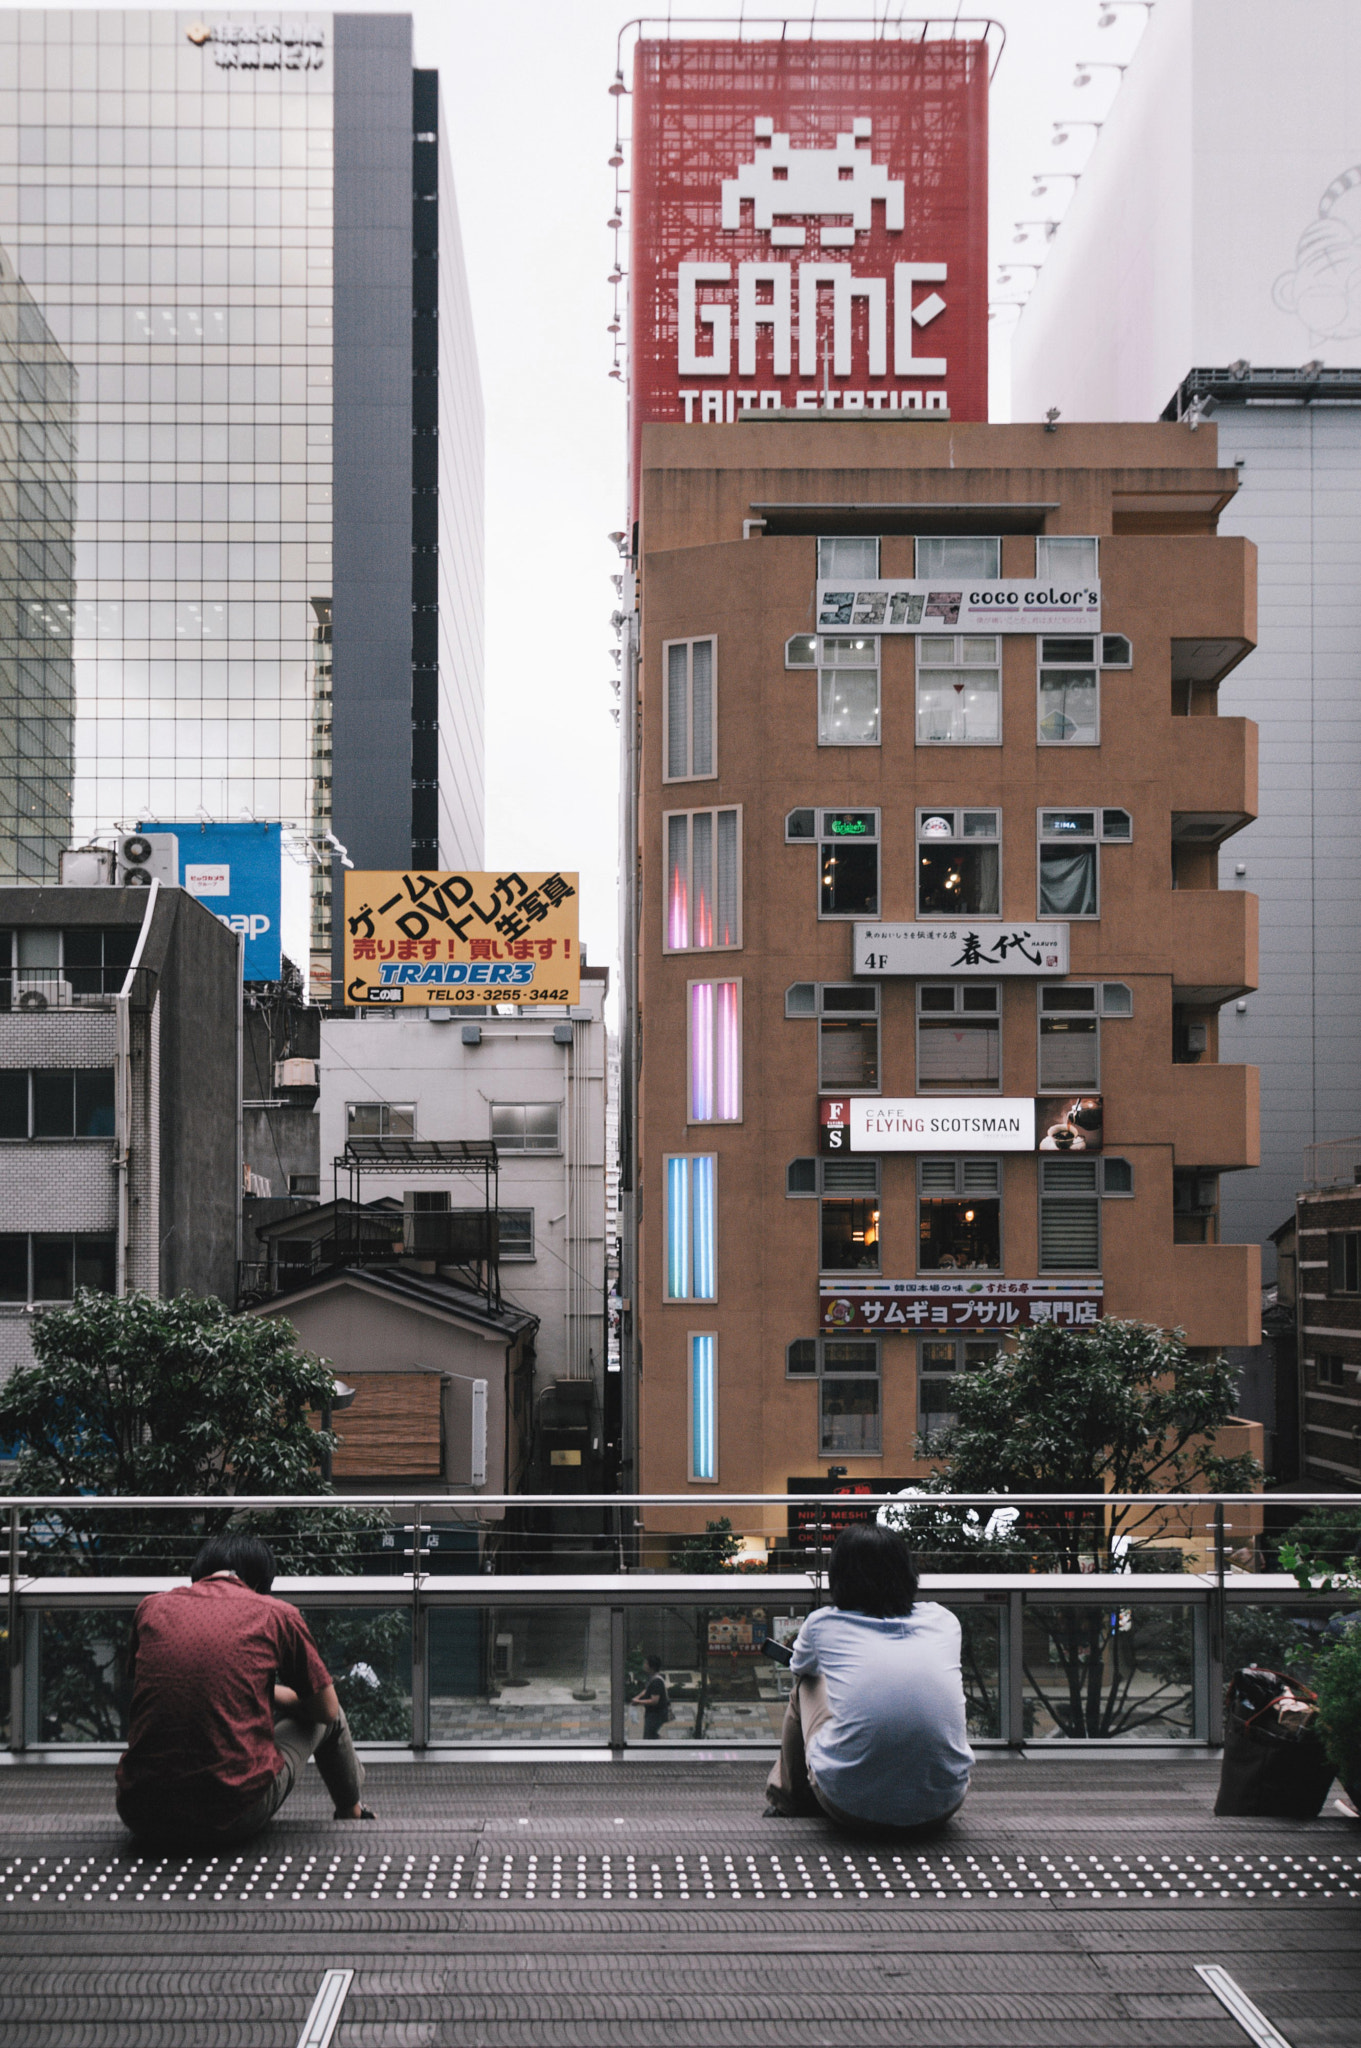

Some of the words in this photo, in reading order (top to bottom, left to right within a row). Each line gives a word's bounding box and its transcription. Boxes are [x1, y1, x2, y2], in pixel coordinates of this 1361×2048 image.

[678, 262, 947, 375] GAME
[819, 592, 963, 625] ココカラ
[969, 591, 1019, 605] coco
[1054, 821, 1077, 830] ZIMA
[348, 874, 438, 939] ゲーム
[395, 876, 473, 940] DVD
[446, 872, 529, 943] トレカ
[494, 872, 575, 943] 生写真
[950, 931, 1042, 967] 春代
[864, 953, 889, 969] 4F
[829, 1102, 844, 1120] F
[866, 1109, 905, 1118] CAFE
[866, 1118, 925, 1133] FLYING
[930, 1118, 1020, 1132] SCOTSMAN
[829, 1130, 843, 1148] S
[860, 1300, 1020, 1324] サムギョプサル
[1028, 1300, 1098, 1324] 専門店
[831, 1511, 868, 1520] MESHI
